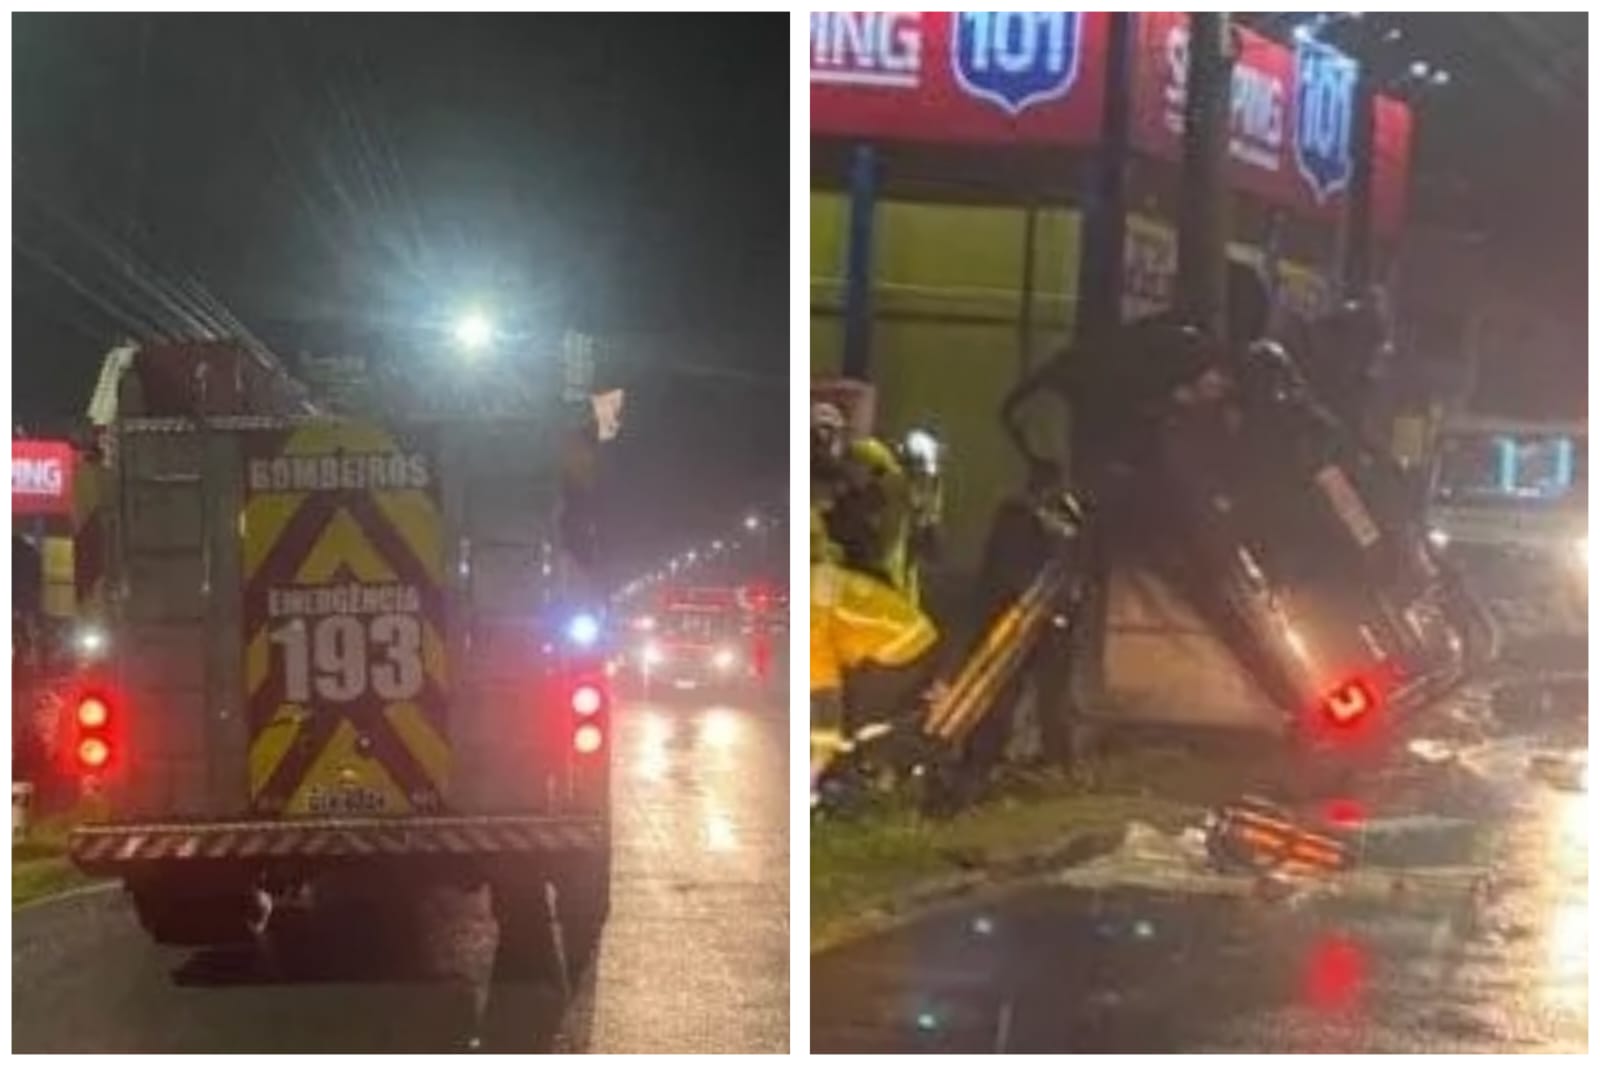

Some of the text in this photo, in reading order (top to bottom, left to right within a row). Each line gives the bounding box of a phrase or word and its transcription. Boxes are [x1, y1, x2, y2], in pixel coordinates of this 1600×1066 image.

[966, 12, 1065, 71] 101
[251, 453, 428, 491] BOMBEIROS
[270, 614, 422, 701] 193
